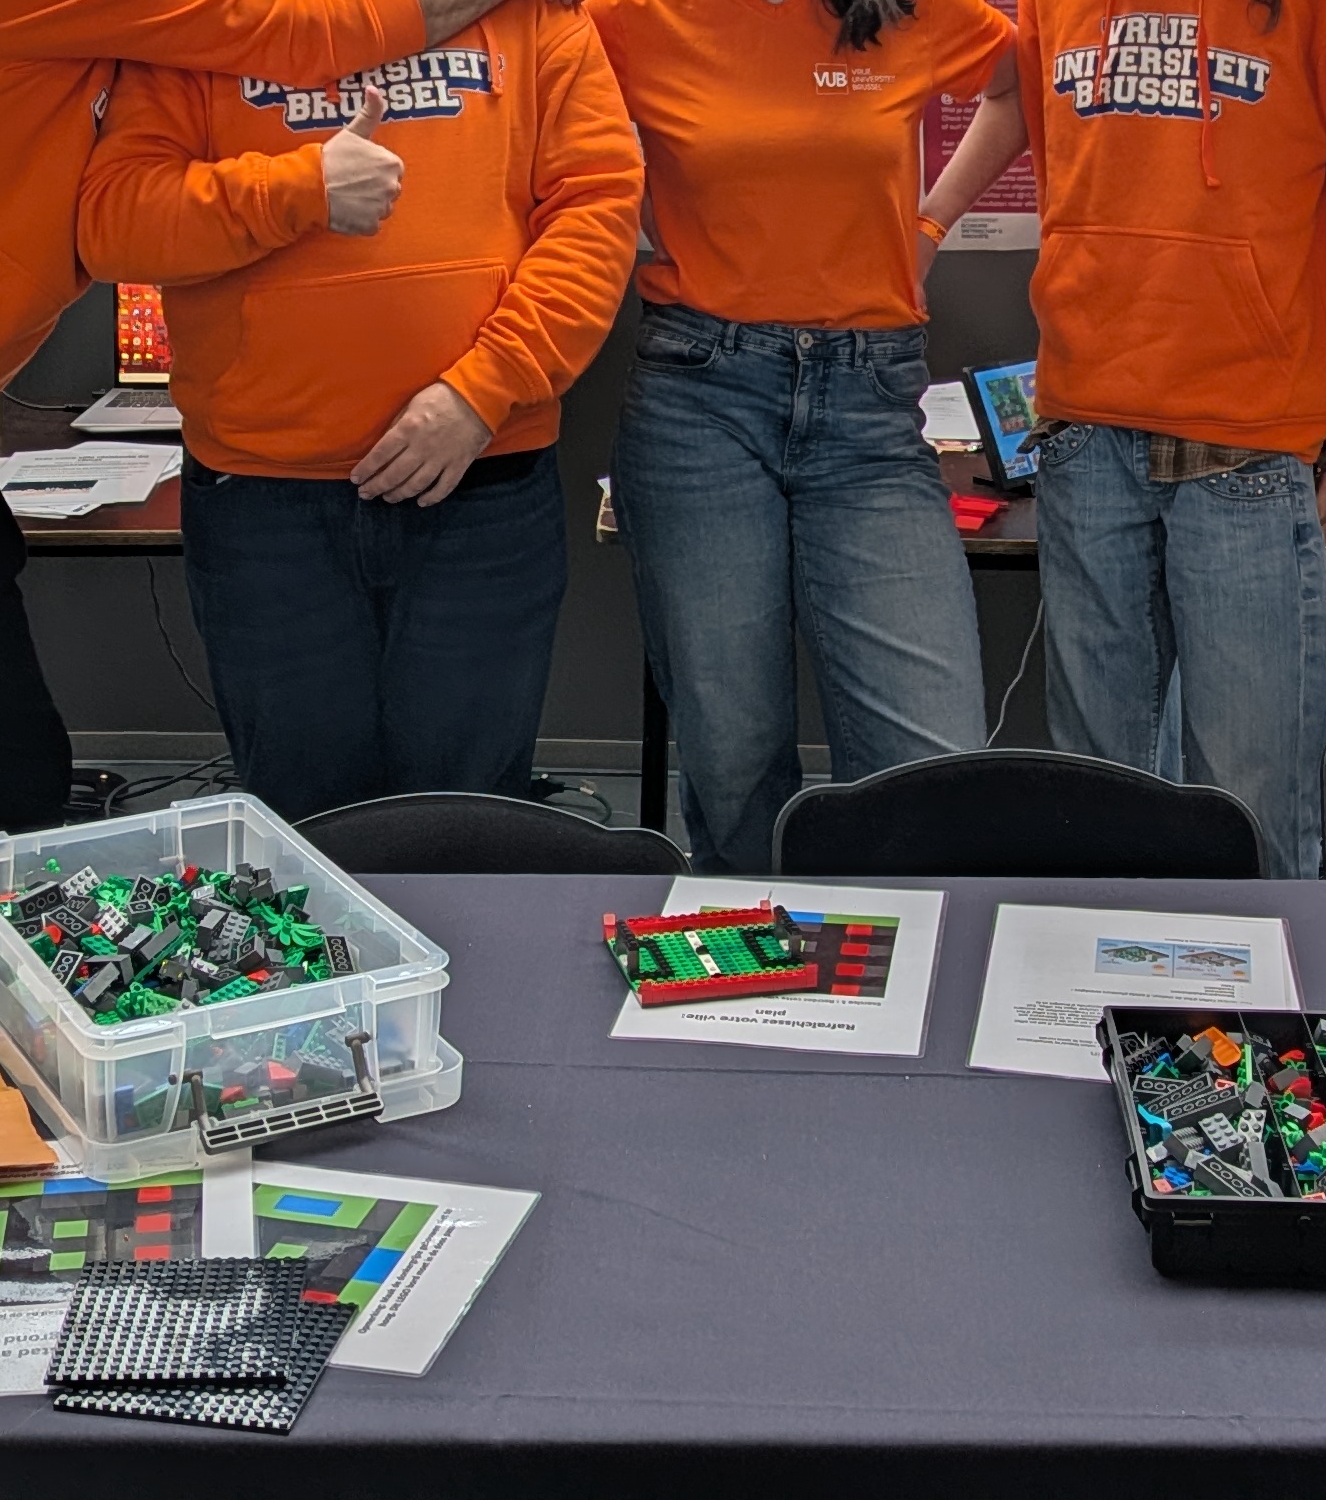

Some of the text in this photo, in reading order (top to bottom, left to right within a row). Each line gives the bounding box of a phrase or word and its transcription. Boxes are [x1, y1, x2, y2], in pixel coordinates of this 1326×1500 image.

[813, 71, 848, 88] VUB
[755, 1008, 787, 1017] plan
[720, 1016, 758, 1025] votre
